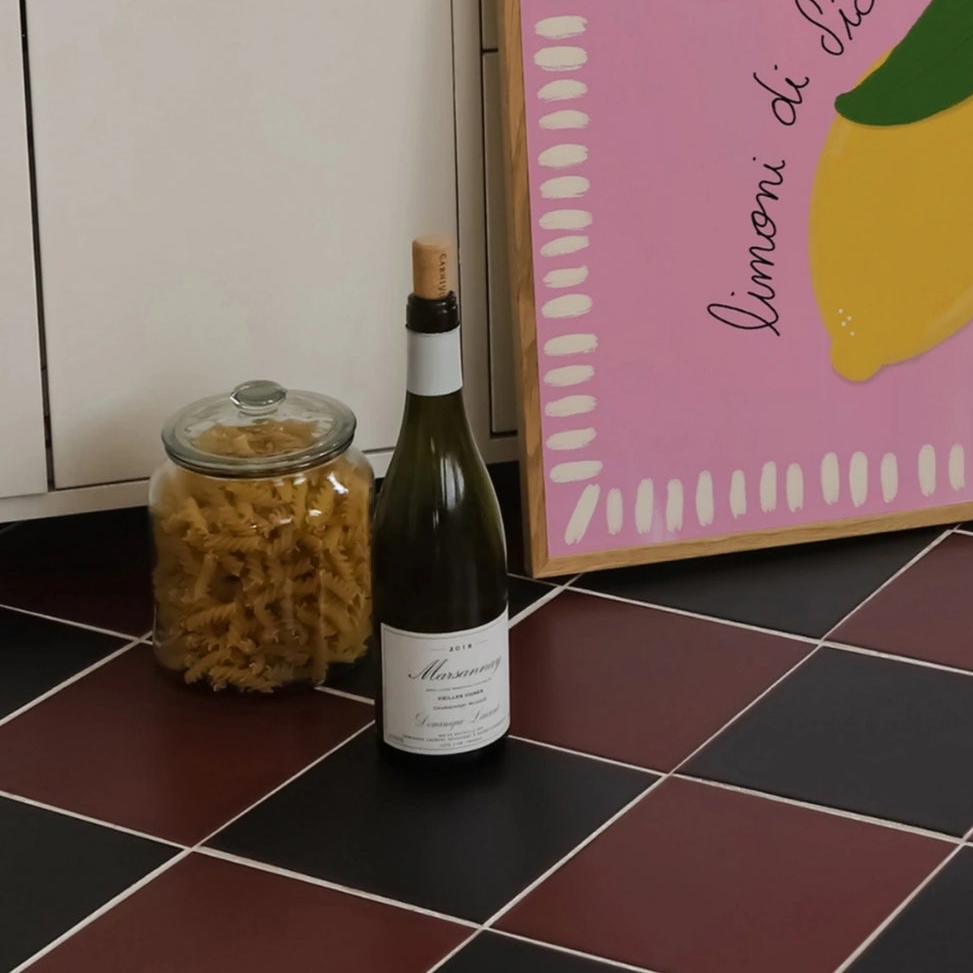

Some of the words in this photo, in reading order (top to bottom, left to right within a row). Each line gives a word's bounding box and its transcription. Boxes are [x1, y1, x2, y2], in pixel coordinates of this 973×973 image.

[707, 156, 786, 337] limoni
[753, 64, 810, 126] di
[449, 643, 472, 652] 2018
